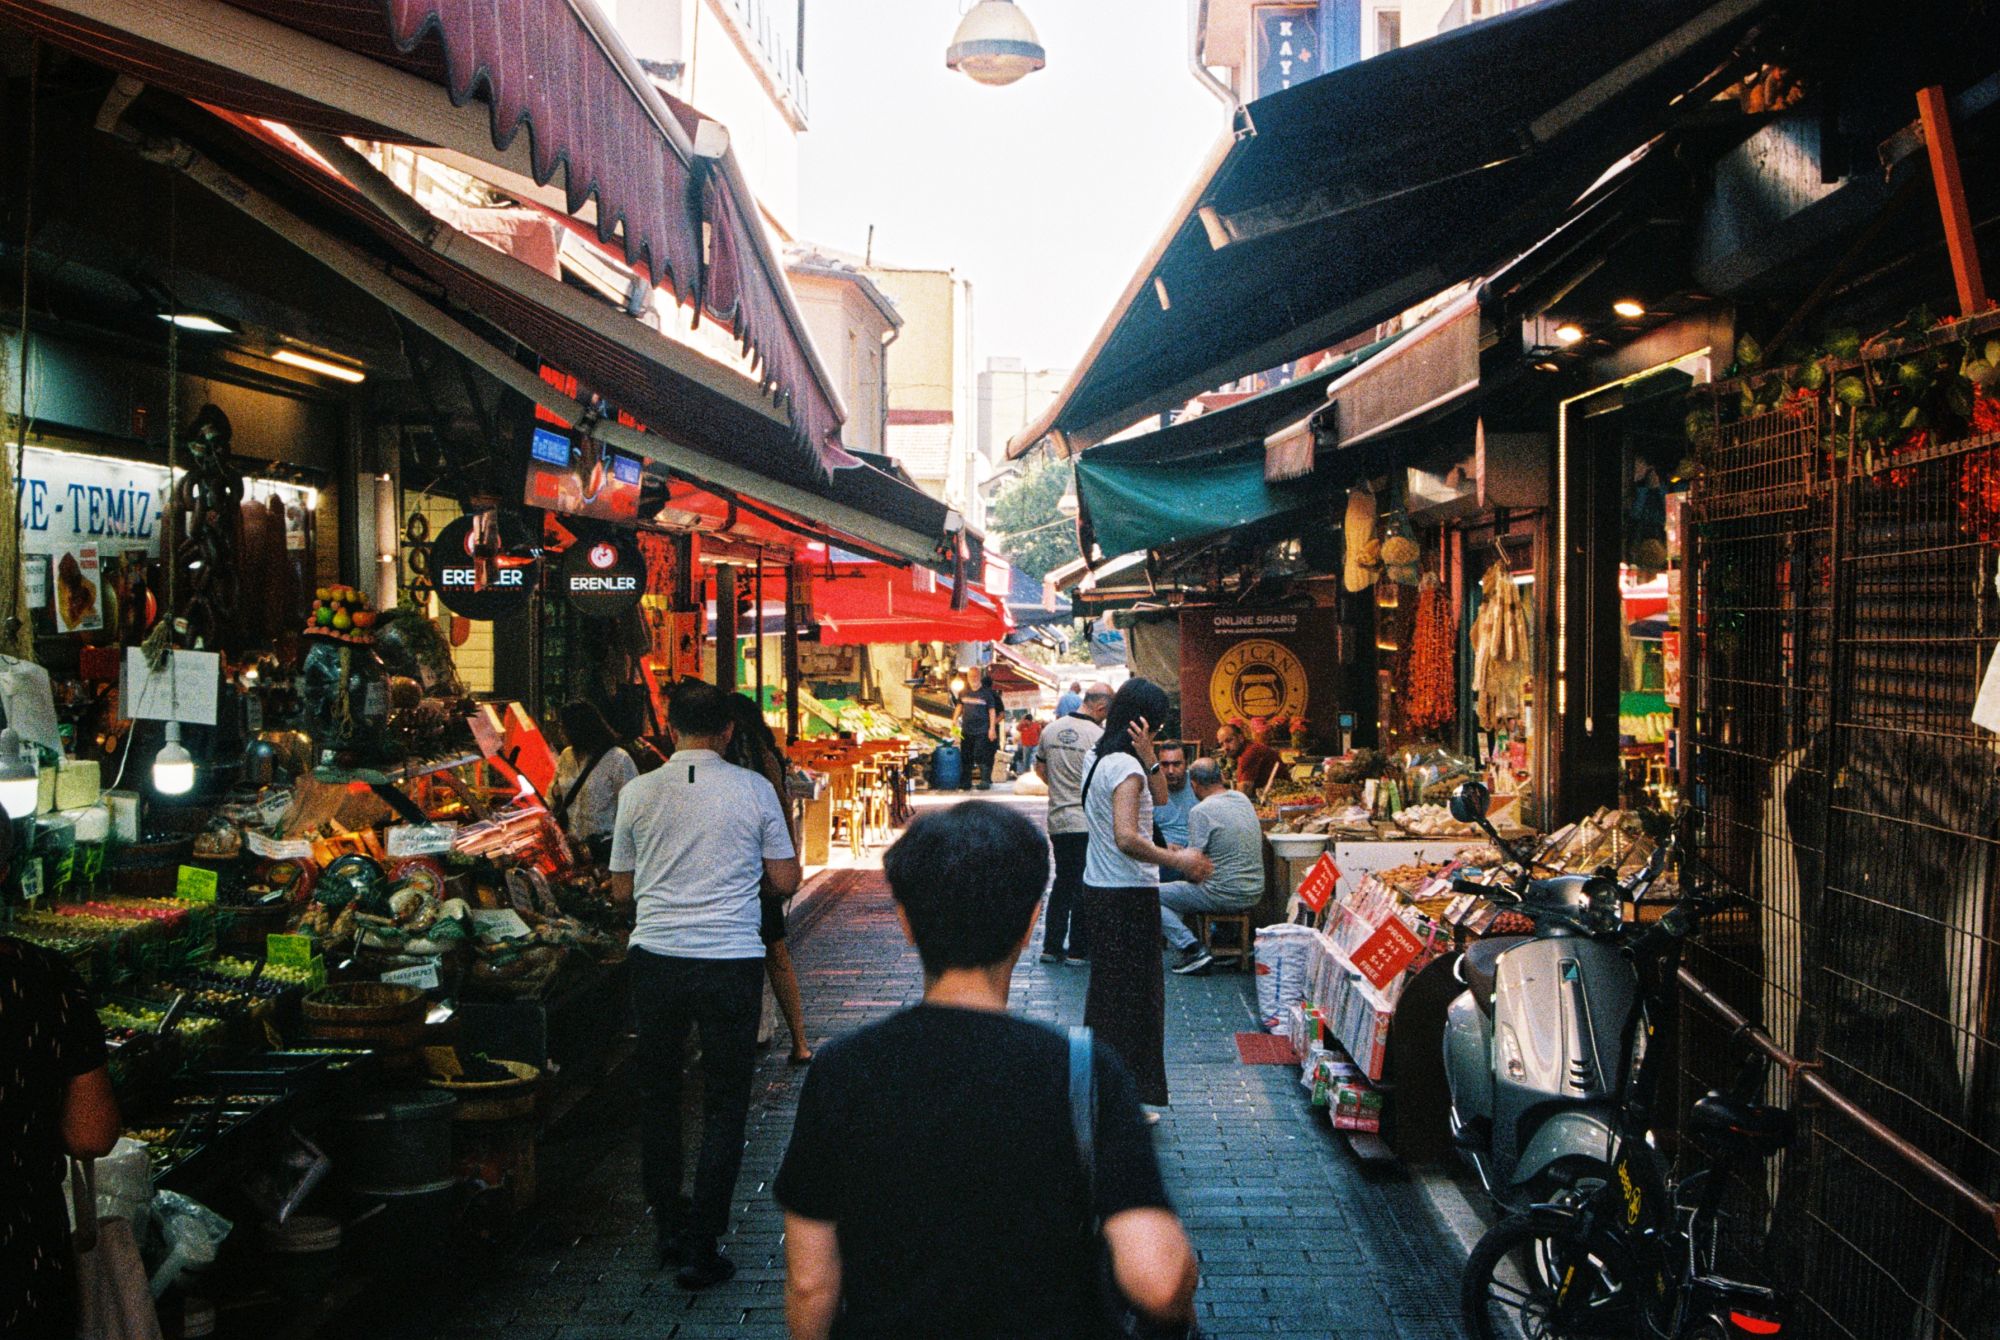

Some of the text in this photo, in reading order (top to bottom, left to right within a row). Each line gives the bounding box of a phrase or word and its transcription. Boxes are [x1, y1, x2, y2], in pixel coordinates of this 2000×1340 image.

[67, 480, 153, 540] TEMİZ
[442, 569, 524, 585] EREER
[570, 577, 636, 590] ERENLER
[1385, 924, 1415, 953] PROMO
[1385, 939, 1400, 955] 3+1
[1370, 954, 1385, 971] 5+1
[1377, 948, 1393, 963] 4+1
[1359, 959, 1381, 981] FREE
